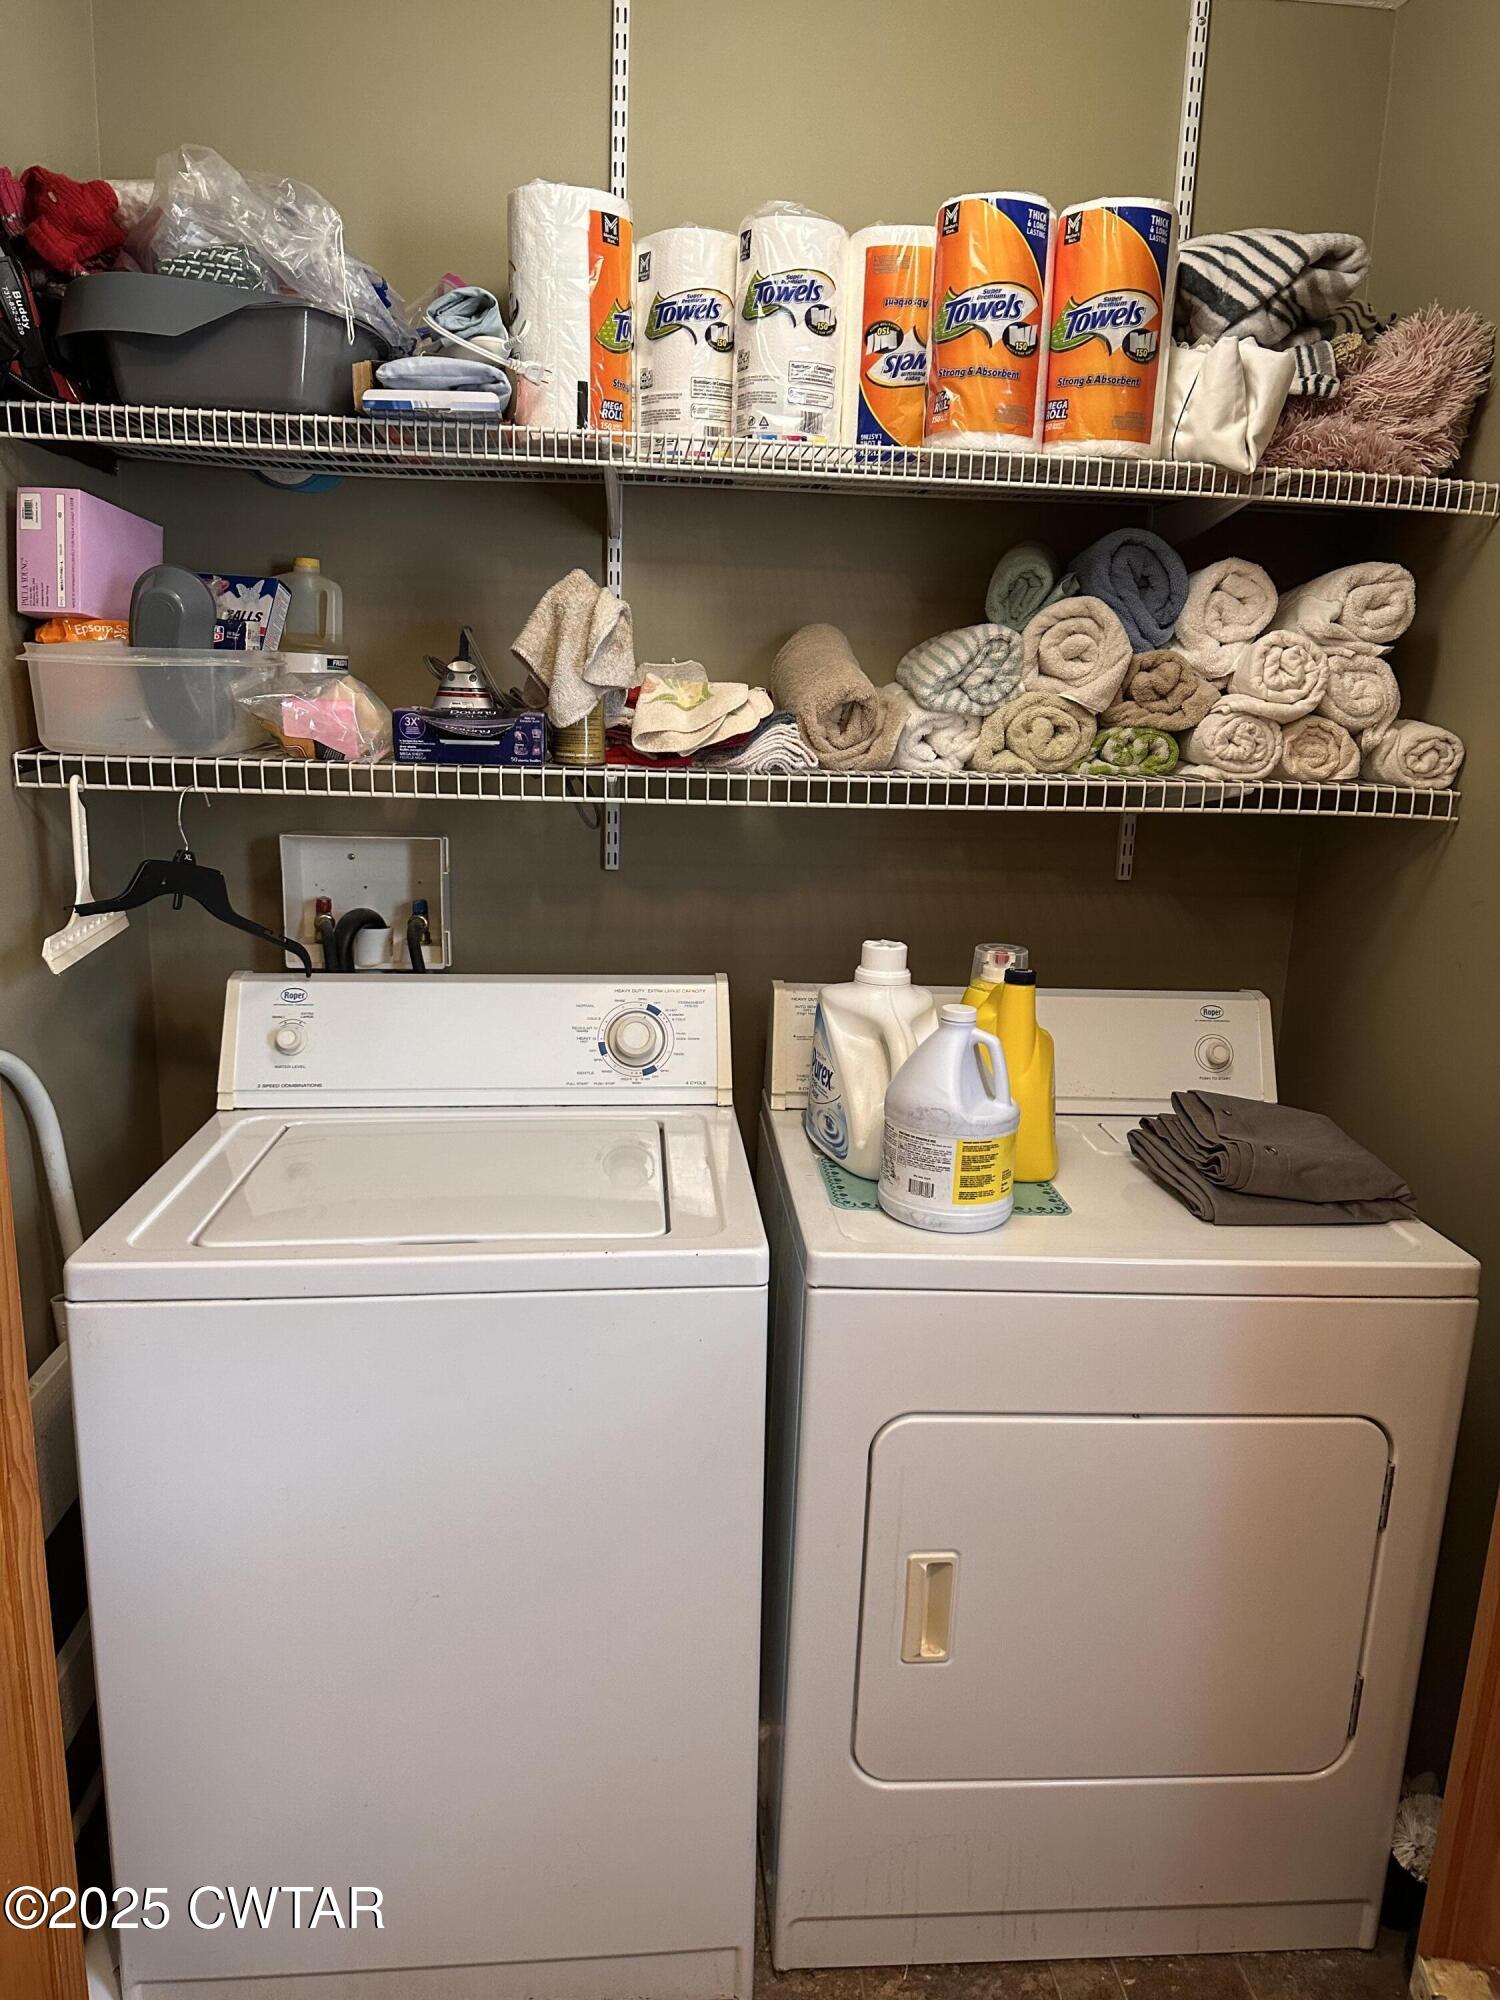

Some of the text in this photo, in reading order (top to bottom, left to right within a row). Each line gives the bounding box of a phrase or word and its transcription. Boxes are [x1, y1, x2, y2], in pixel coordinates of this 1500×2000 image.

[1028, 208, 1048, 223] THICK
[1150, 214, 1169, 228] THICK
[1033, 220, 1047, 232] LONG
[1026, 227, 1047, 240] LASTING
[1148, 232, 1168, 246] LASTING
[753, 279, 824, 310] Towels
[976, 293, 1007, 301] Premium
[884, 298, 929, 308] Absorbent
[11, 290, 31, 330] Buddy
[655, 297, 723, 330] Towels
[945, 293, 1024, 332] Towels
[816, 322, 829, 331] 150
[1064, 300, 1145, 341] Towels
[877, 326, 891, 336] 150
[1015, 342, 1028, 351] 150
[1136, 348, 1148, 358] 150
[938, 367, 966, 378] Strong
[975, 366, 1020, 380] Absorbent
[1056, 377, 1085, 388] Strong
[1093, 375, 1141, 387] Absorbent
[602, 400, 623, 411] MEGA
[602, 408, 624, 420] ROLL
[284, 991, 305, 1000] Roper
[1203, 1008, 1221, 1017] Roper
